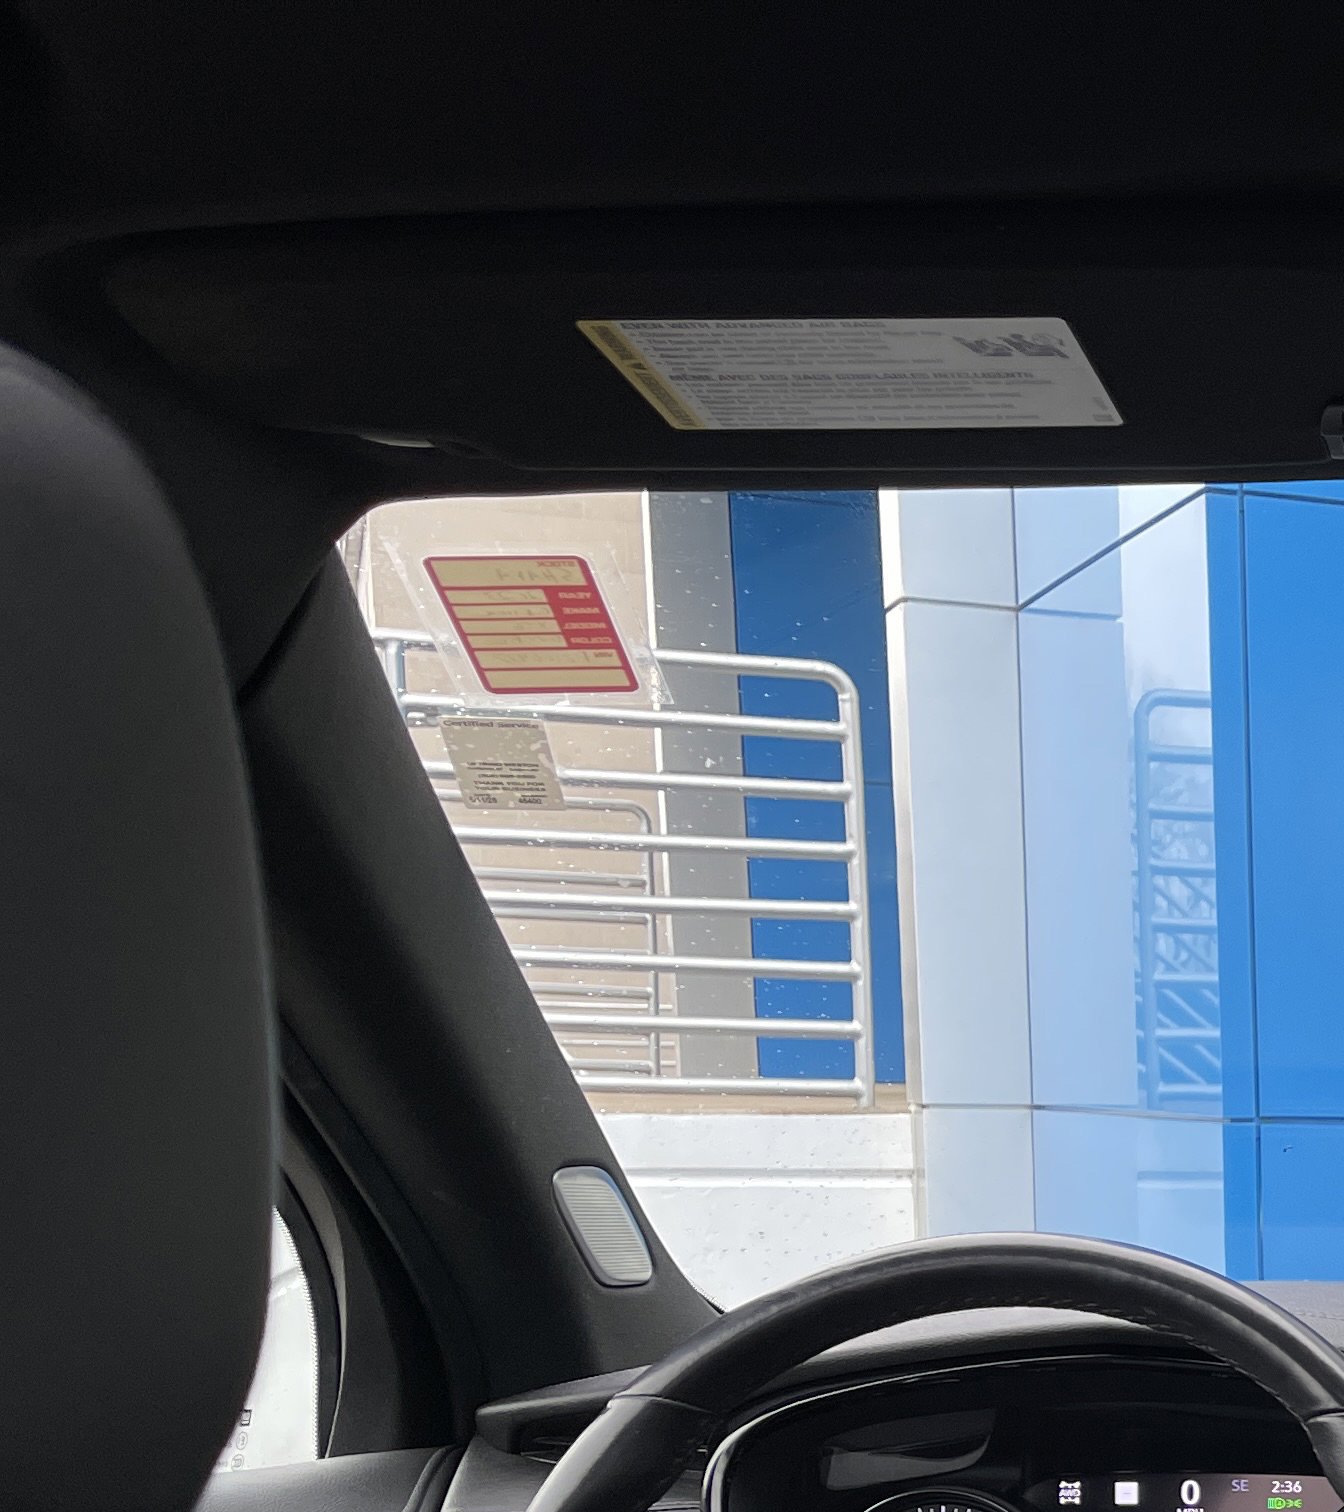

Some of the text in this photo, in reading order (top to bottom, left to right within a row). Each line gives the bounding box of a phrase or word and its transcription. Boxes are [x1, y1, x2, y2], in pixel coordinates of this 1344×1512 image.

[443, 720, 539, 730] Certified Service
[1180, 1479, 1201, 1505] 0
[1231, 1479, 1250, 1492] SE
[1271, 1480, 1303, 1494] 2:36
